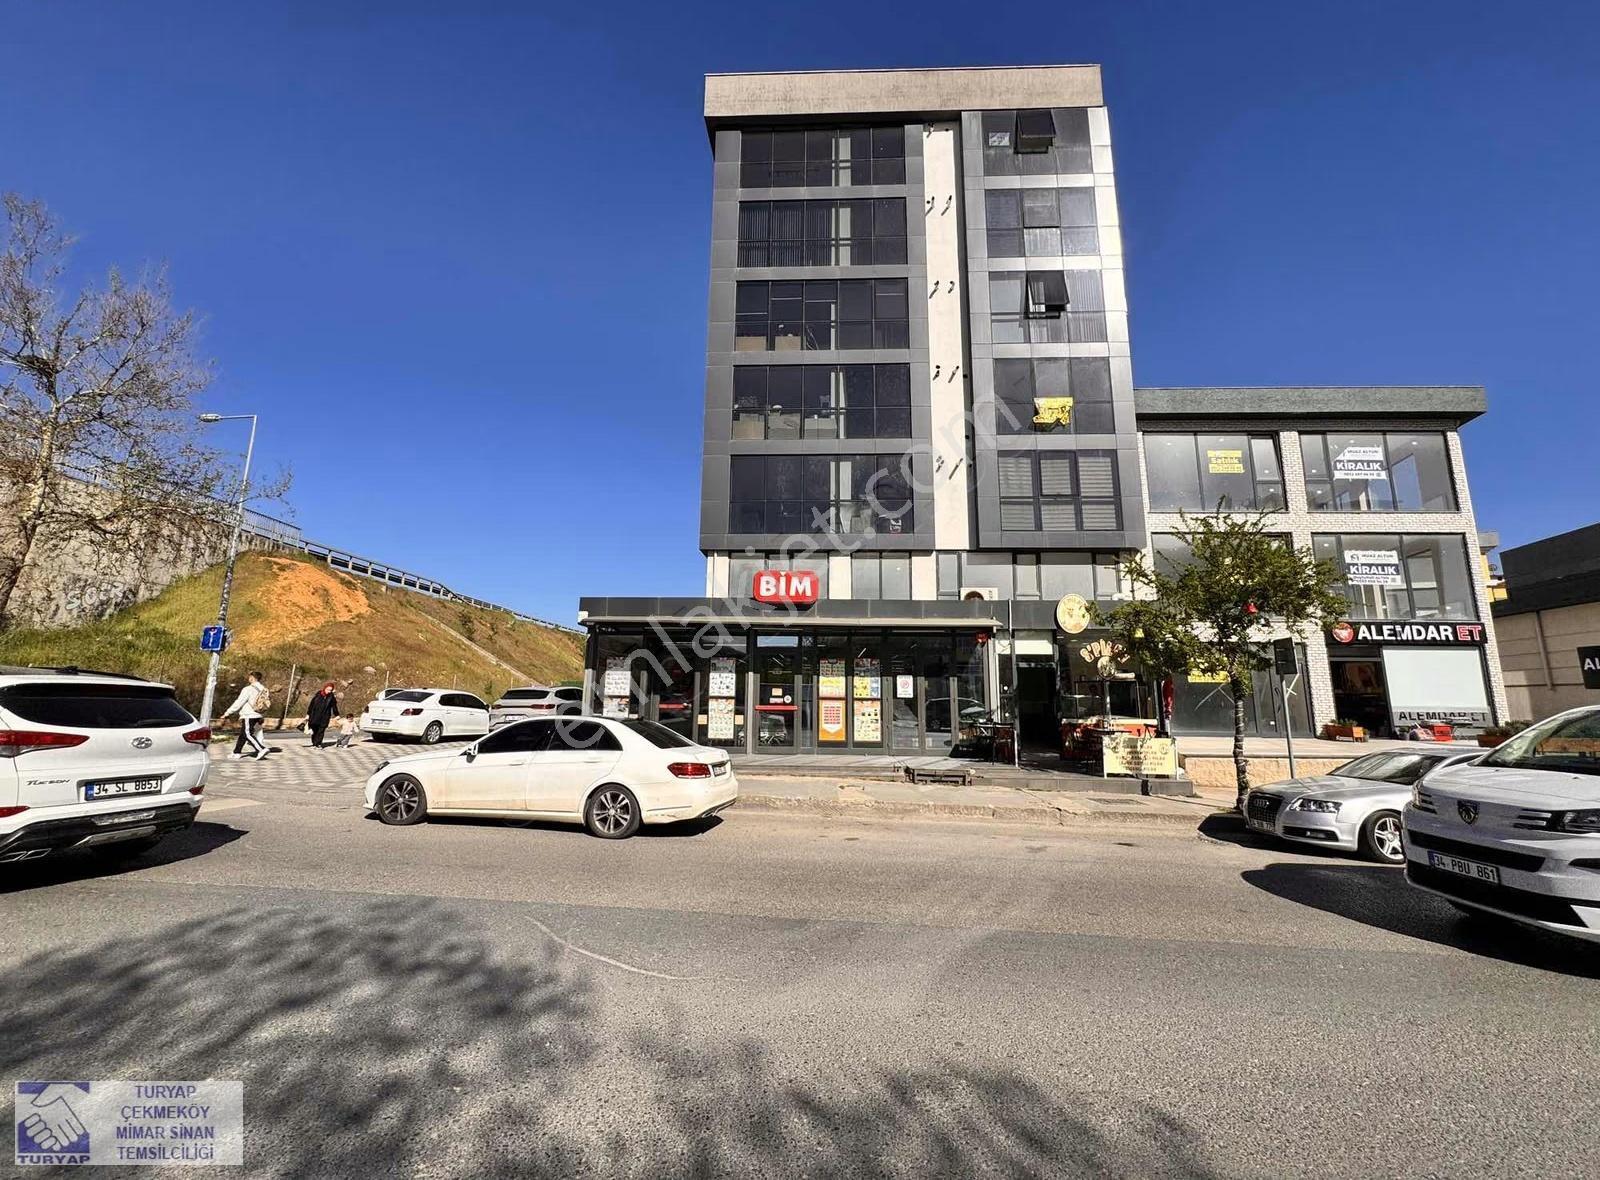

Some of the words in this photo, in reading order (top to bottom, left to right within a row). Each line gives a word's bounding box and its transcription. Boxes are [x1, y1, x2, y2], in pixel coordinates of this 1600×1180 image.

[1336, 459, 1381, 470] KİRALIK
[1350, 563, 1397, 575] KİRALIK
[760, 572, 812, 597] BİM
[1357, 624, 1454, 641] ALEMDAR
[1456, 625, 1482, 641] ET
[95, 783, 108, 795] 34
[115, 782, 128, 793] SL
[134, 780, 159, 791] 8853
[1434, 854, 1446, 868] 34
[1451, 859, 1471, 874] PBU
[1476, 865, 1496, 881] 861
